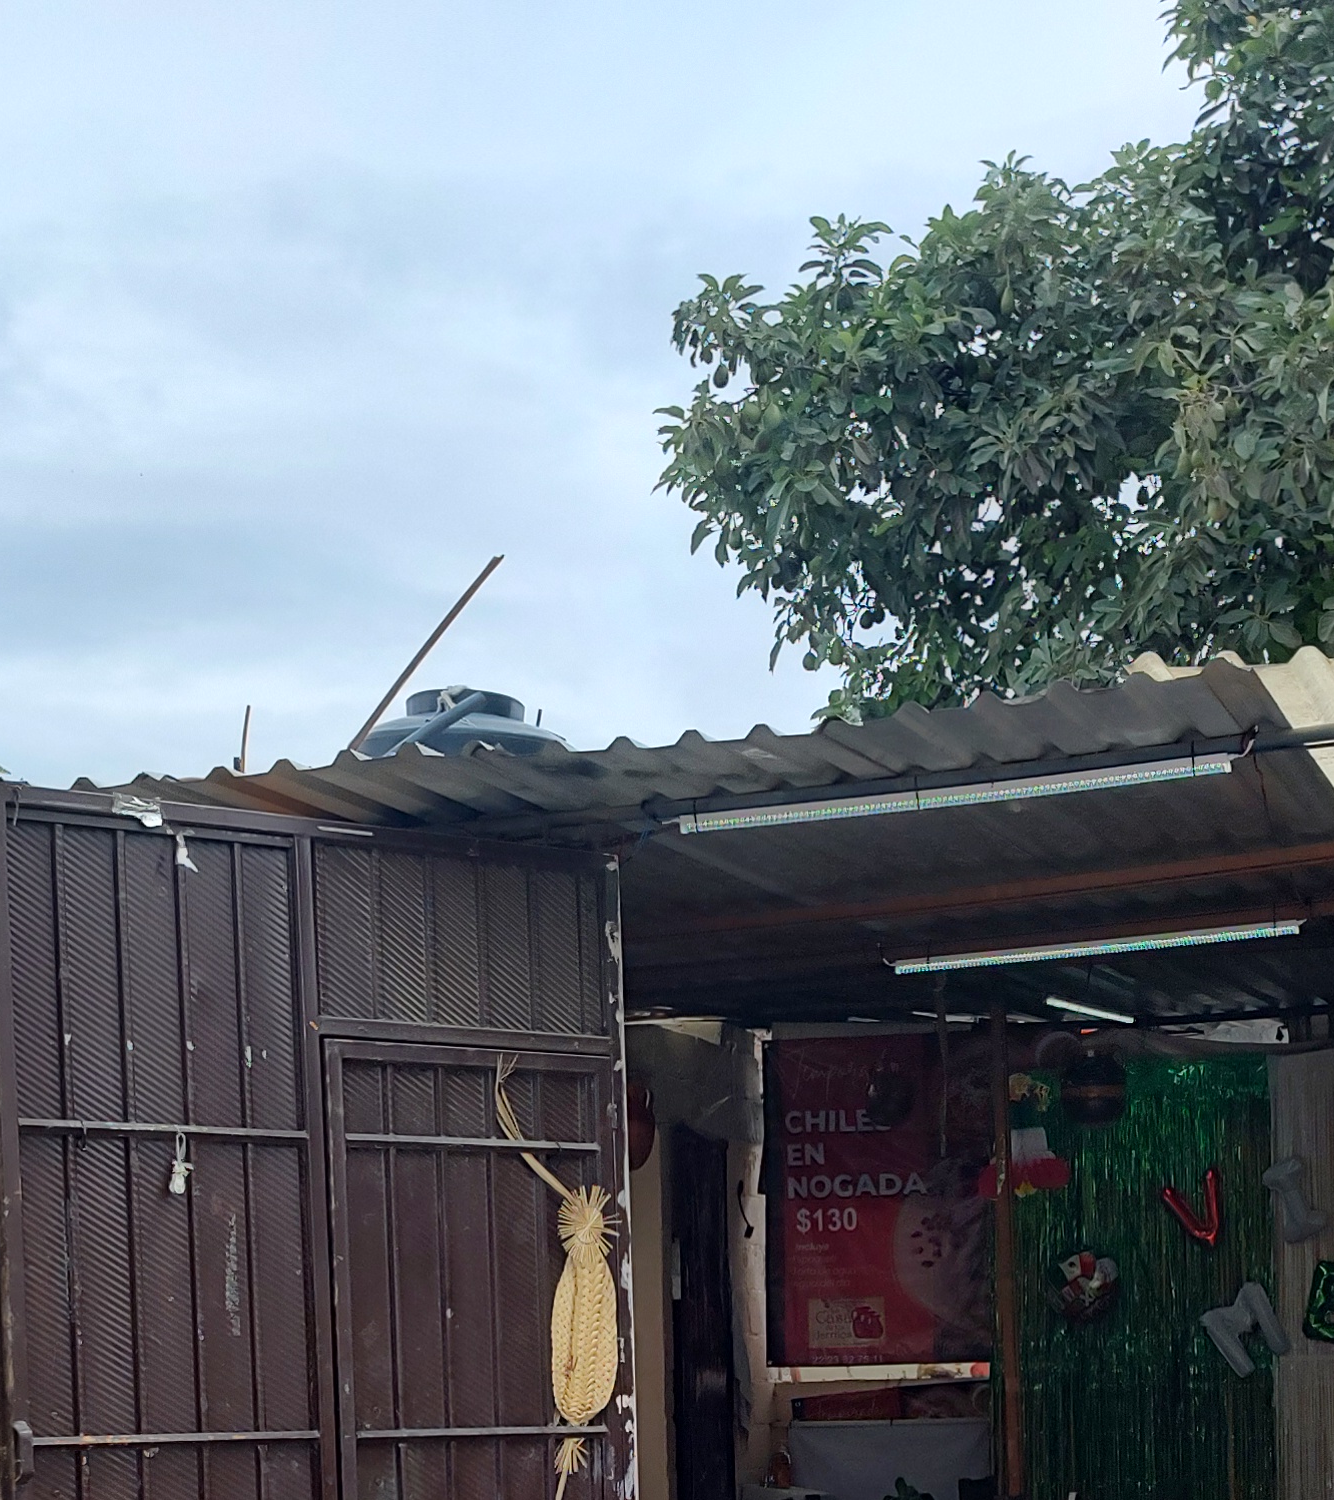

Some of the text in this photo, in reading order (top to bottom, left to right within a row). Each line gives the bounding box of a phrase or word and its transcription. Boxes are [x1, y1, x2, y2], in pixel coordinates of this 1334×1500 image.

[785, 1108, 891, 1134] CHILE
[786, 1143, 825, 1167] EN
[787, 1172, 928, 1200] NOGADA
[796, 1207, 858, 1235] $130
